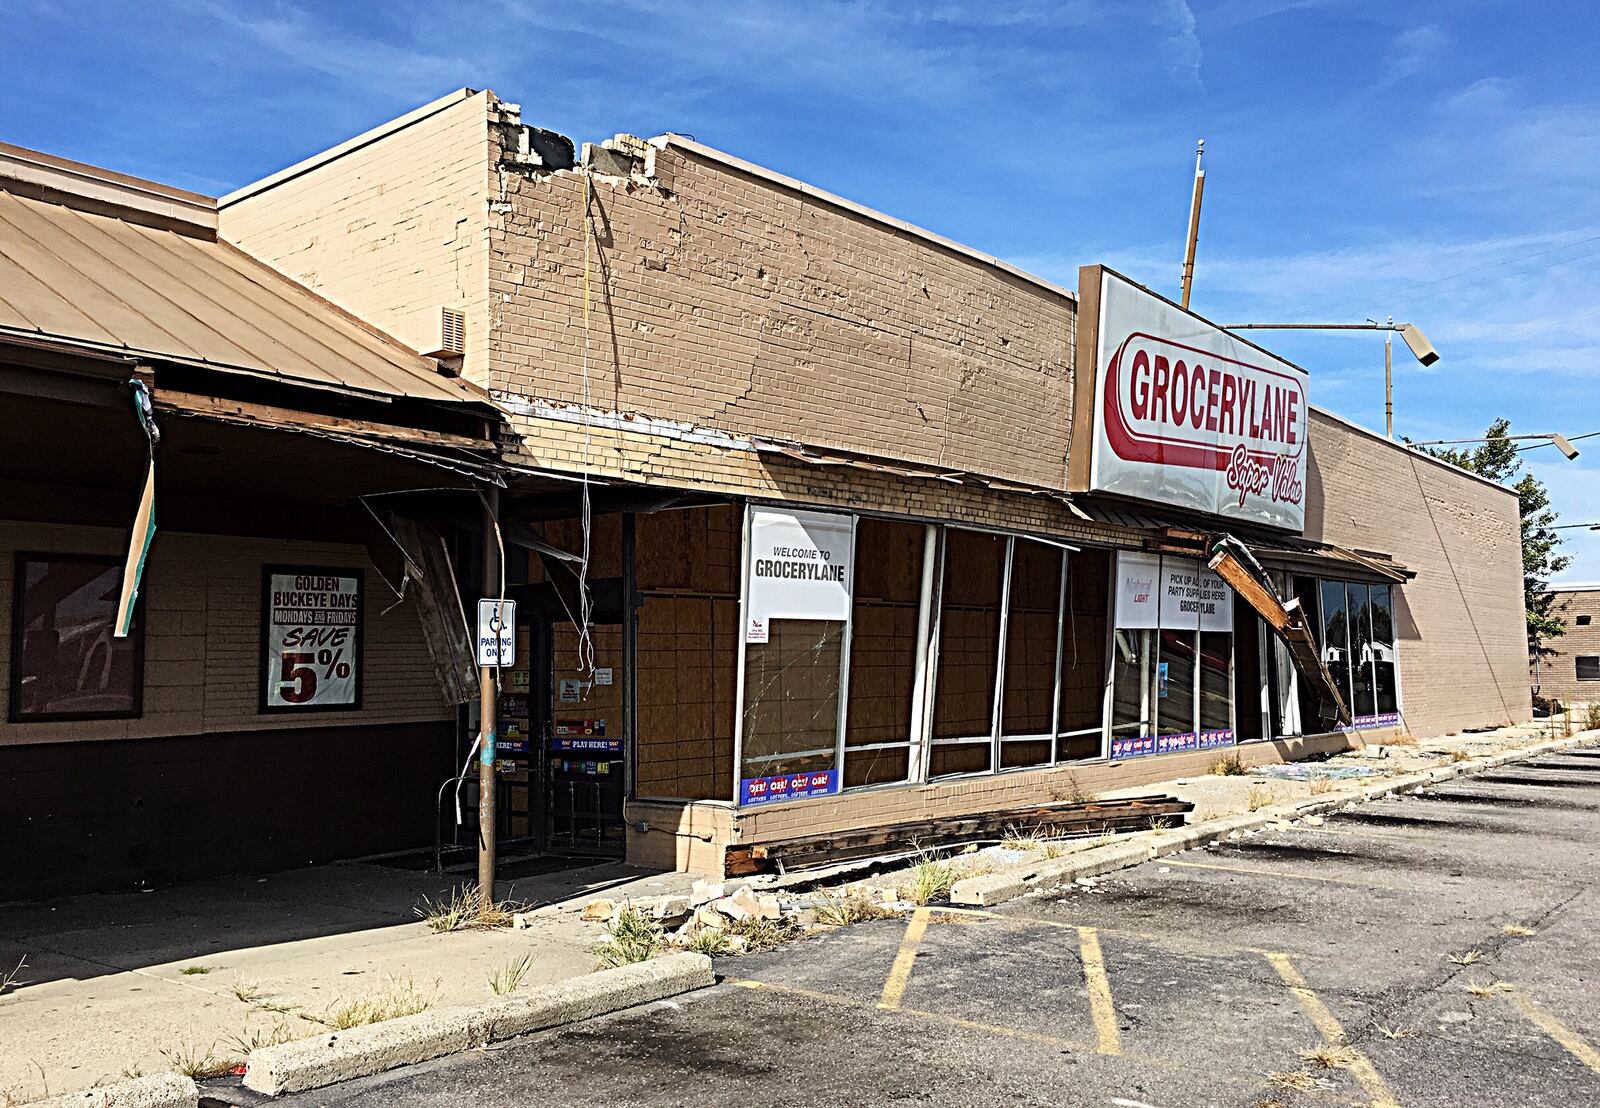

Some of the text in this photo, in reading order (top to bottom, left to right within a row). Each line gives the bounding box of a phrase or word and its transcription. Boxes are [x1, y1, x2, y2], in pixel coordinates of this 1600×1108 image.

[1130, 349, 1298, 445] GROCERYLANE
[1227, 443, 1269, 508] Super
[773, 546, 831, 561] WELCOME TO
[755, 559, 845, 582] GROCERYLANE
[295, 575, 339, 592] GOLDEN
[1171, 574, 1183, 584] PICK
[1184, 575, 1192, 586] UP
[1203, 579, 1210, 588] OF
[1168, 585, 1185, 597] PARTY
[273, 591, 358, 609] BUCKEYE DAYS
[274, 611, 356, 624] MONDAYS AND FRIDAYS
[281, 627, 350, 648] SAVE
[279, 648, 351, 704] 5%
[588, 741, 608, 749] HERE!
[770, 779, 788, 790] OH!
[811, 774, 828, 786] OH!
